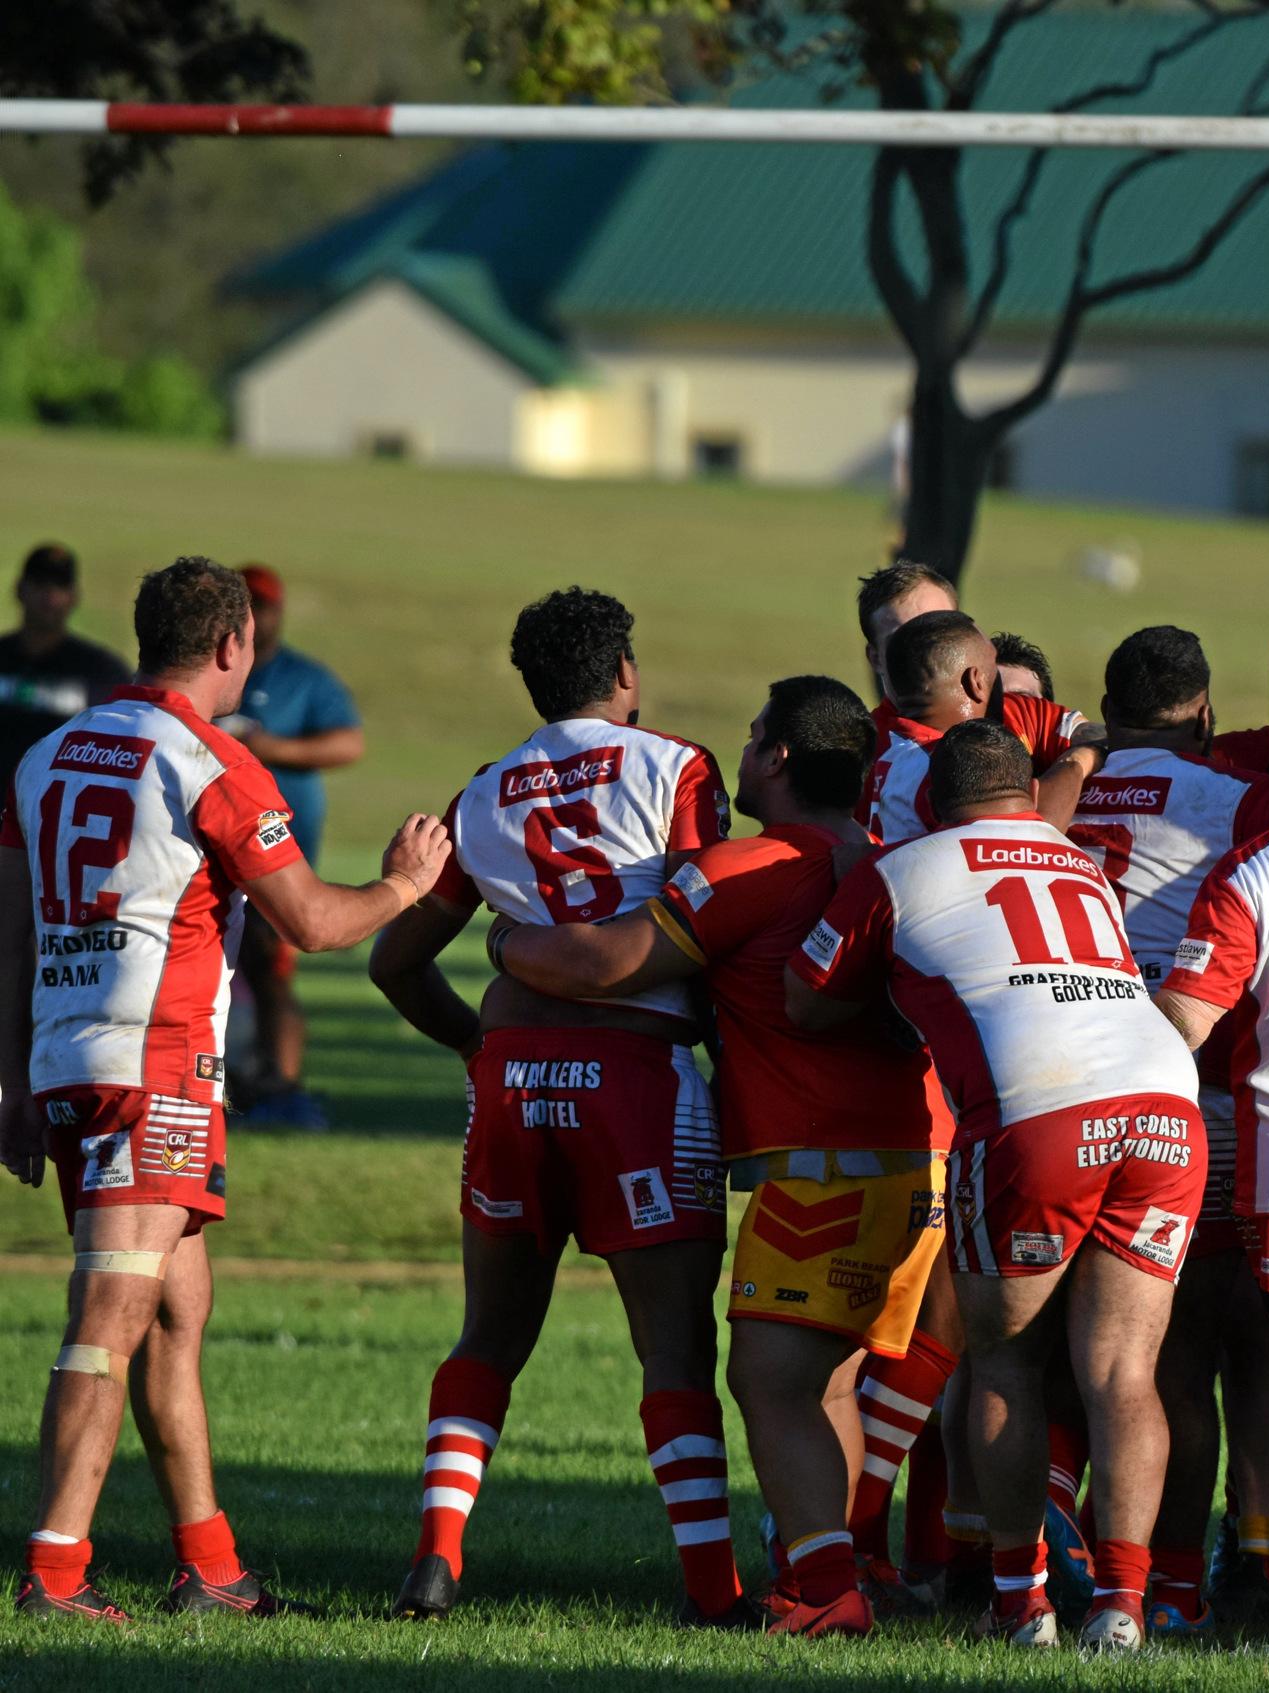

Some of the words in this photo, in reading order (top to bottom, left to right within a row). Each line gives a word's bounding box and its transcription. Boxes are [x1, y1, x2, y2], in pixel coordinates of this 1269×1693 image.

[57, 740, 143, 769] Ladbrokes
[505, 757, 614, 797] Ladbrokes
[1079, 785, 1160, 806] dbrokes
[38, 780, 136, 927] 12
[523, 798, 625, 926] 6
[976, 844, 1099, 877] Ladbrokes
[985, 875, 1139, 978] 10
[40, 930, 128, 956] BDIGO
[42, 963, 103, 987] BANK
[1052, 984, 1093, 1003] GOLF
[1095, 984, 1136, 1000] CLUB
[504, 1060, 602, 1089] WALKERS
[521, 1099, 581, 1129] HOTEL
[1081, 1115, 1130, 1141] EAST
[1134, 1114, 1189, 1140] COAST
[168, 1133, 189, 1146] CRL
[1076, 1137, 1192, 1168] ELECTONICS
[106, 1175, 130, 1184] LODGE
[1130, 1244, 1157, 1260] MOTOR
[1143, 1240, 1173, 1256] Jacaranda
[830, 1257, 860, 1270] PARK
